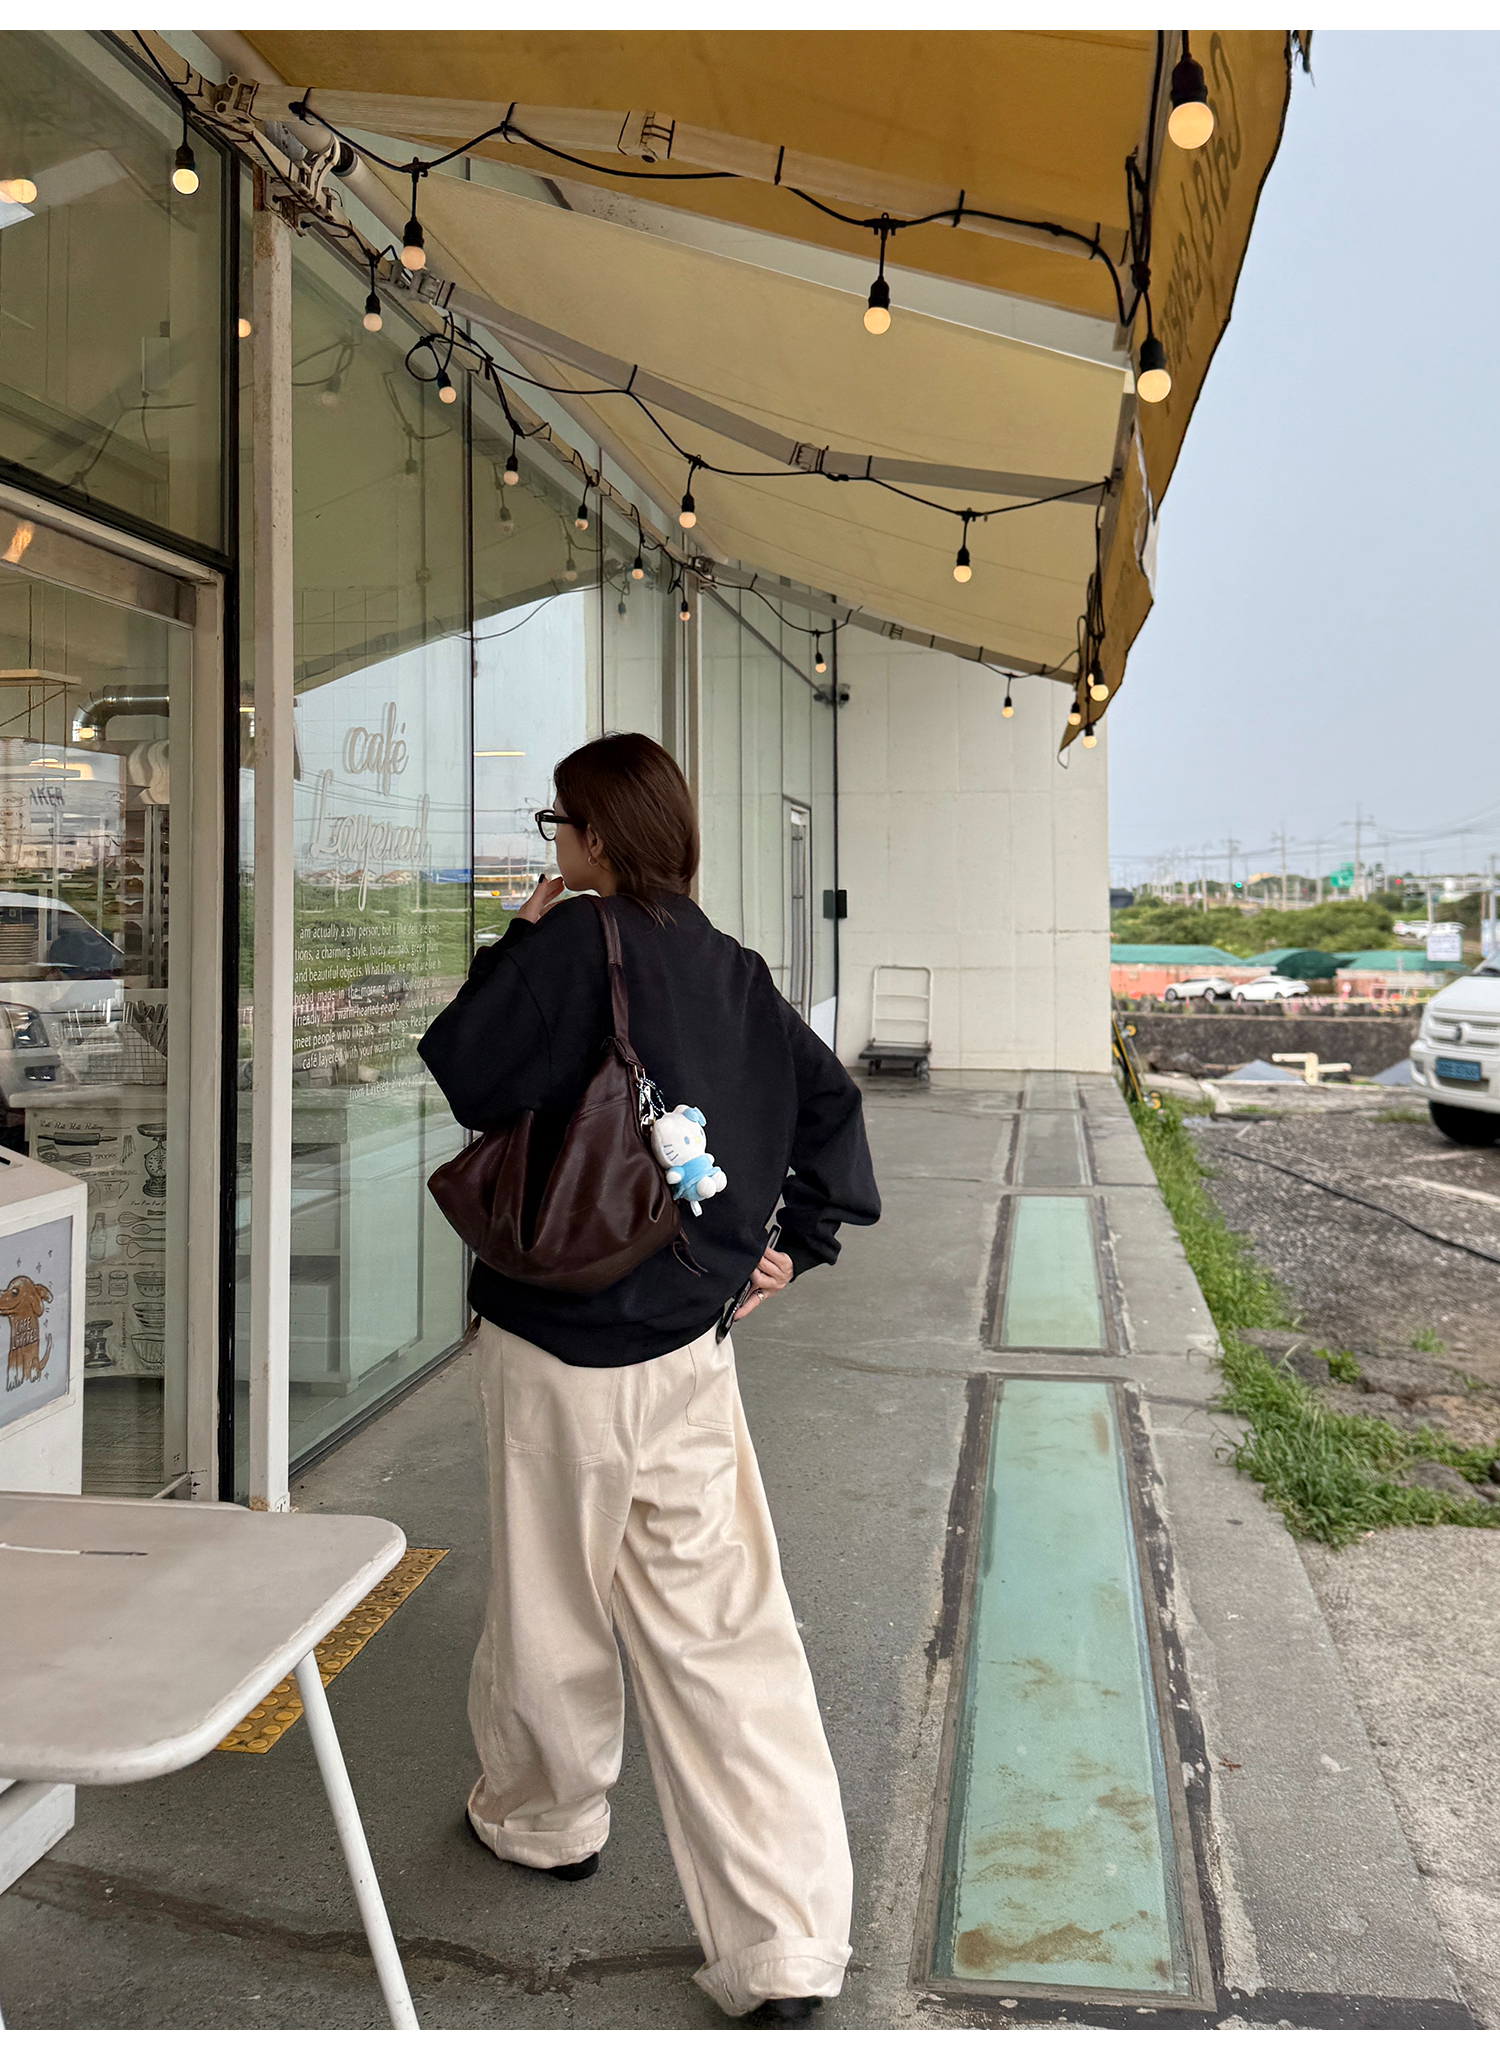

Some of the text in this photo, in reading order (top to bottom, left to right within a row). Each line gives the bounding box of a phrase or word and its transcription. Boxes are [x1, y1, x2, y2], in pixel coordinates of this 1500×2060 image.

[349, 701, 410, 796] café
[310, 768, 430, 912] Layered
[312, 923, 340, 941] actually
[346, 923, 357, 940] shy
[321, 945, 351, 961] charming
[369, 941, 386, 959] lovely
[294, 968, 308, 983] and
[309, 965, 339, 982] beautiful
[294, 989, 314, 1005] bread
[317, 987, 336, 1002] made
[294, 1035, 312, 1050] meet
[312, 1028, 336, 1050] people
[337, 1026, 351, 1041] who
[319, 1047, 343, 1069] layered
[344, 1045, 359, 1060] with
[349, 1086, 365, 1101] from
